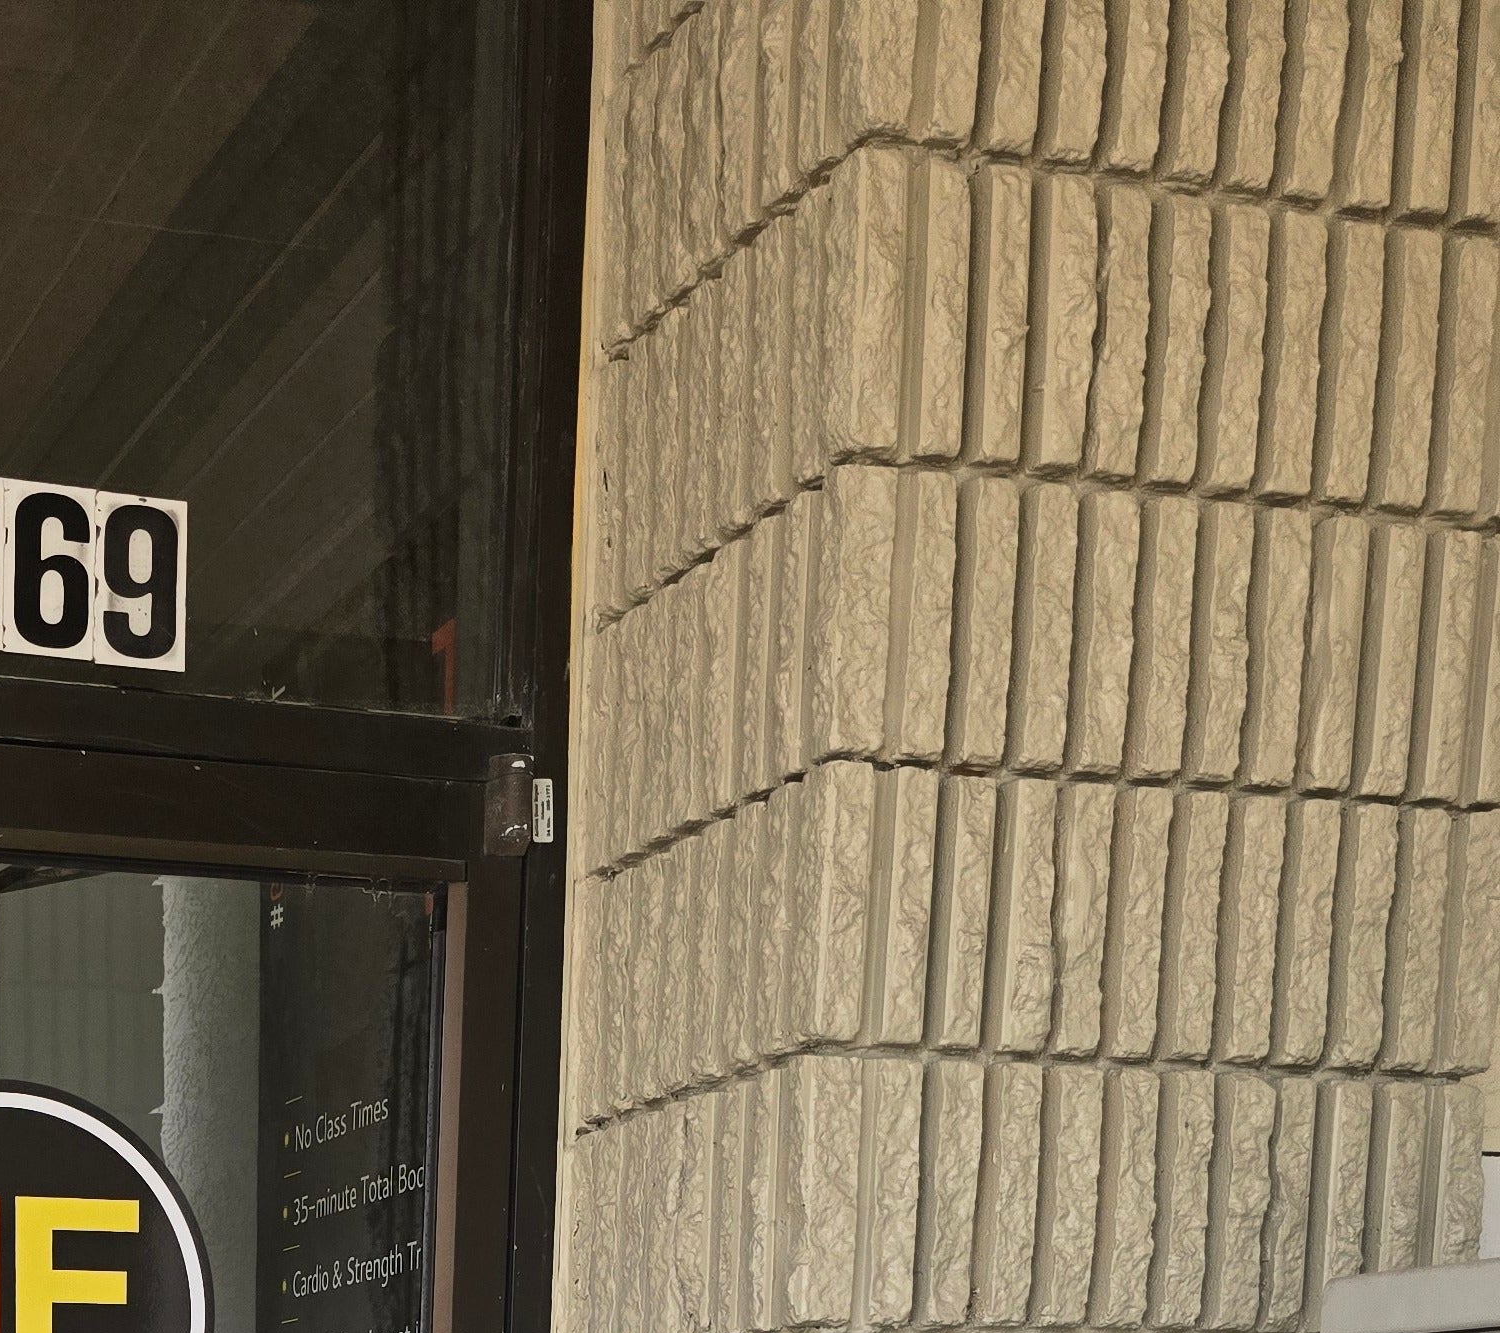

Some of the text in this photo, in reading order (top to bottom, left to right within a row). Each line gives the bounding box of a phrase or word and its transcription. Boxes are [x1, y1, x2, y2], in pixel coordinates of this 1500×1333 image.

[295, 1098, 389, 1152] No Class Times
[293, 1185, 357, 1226] 35-minute
[361, 1165, 393, 1205] Total
[293, 1264, 329, 1298] Cardio
[332, 1260, 343, 1289] &
[346, 1243, 403, 1288] Strength
